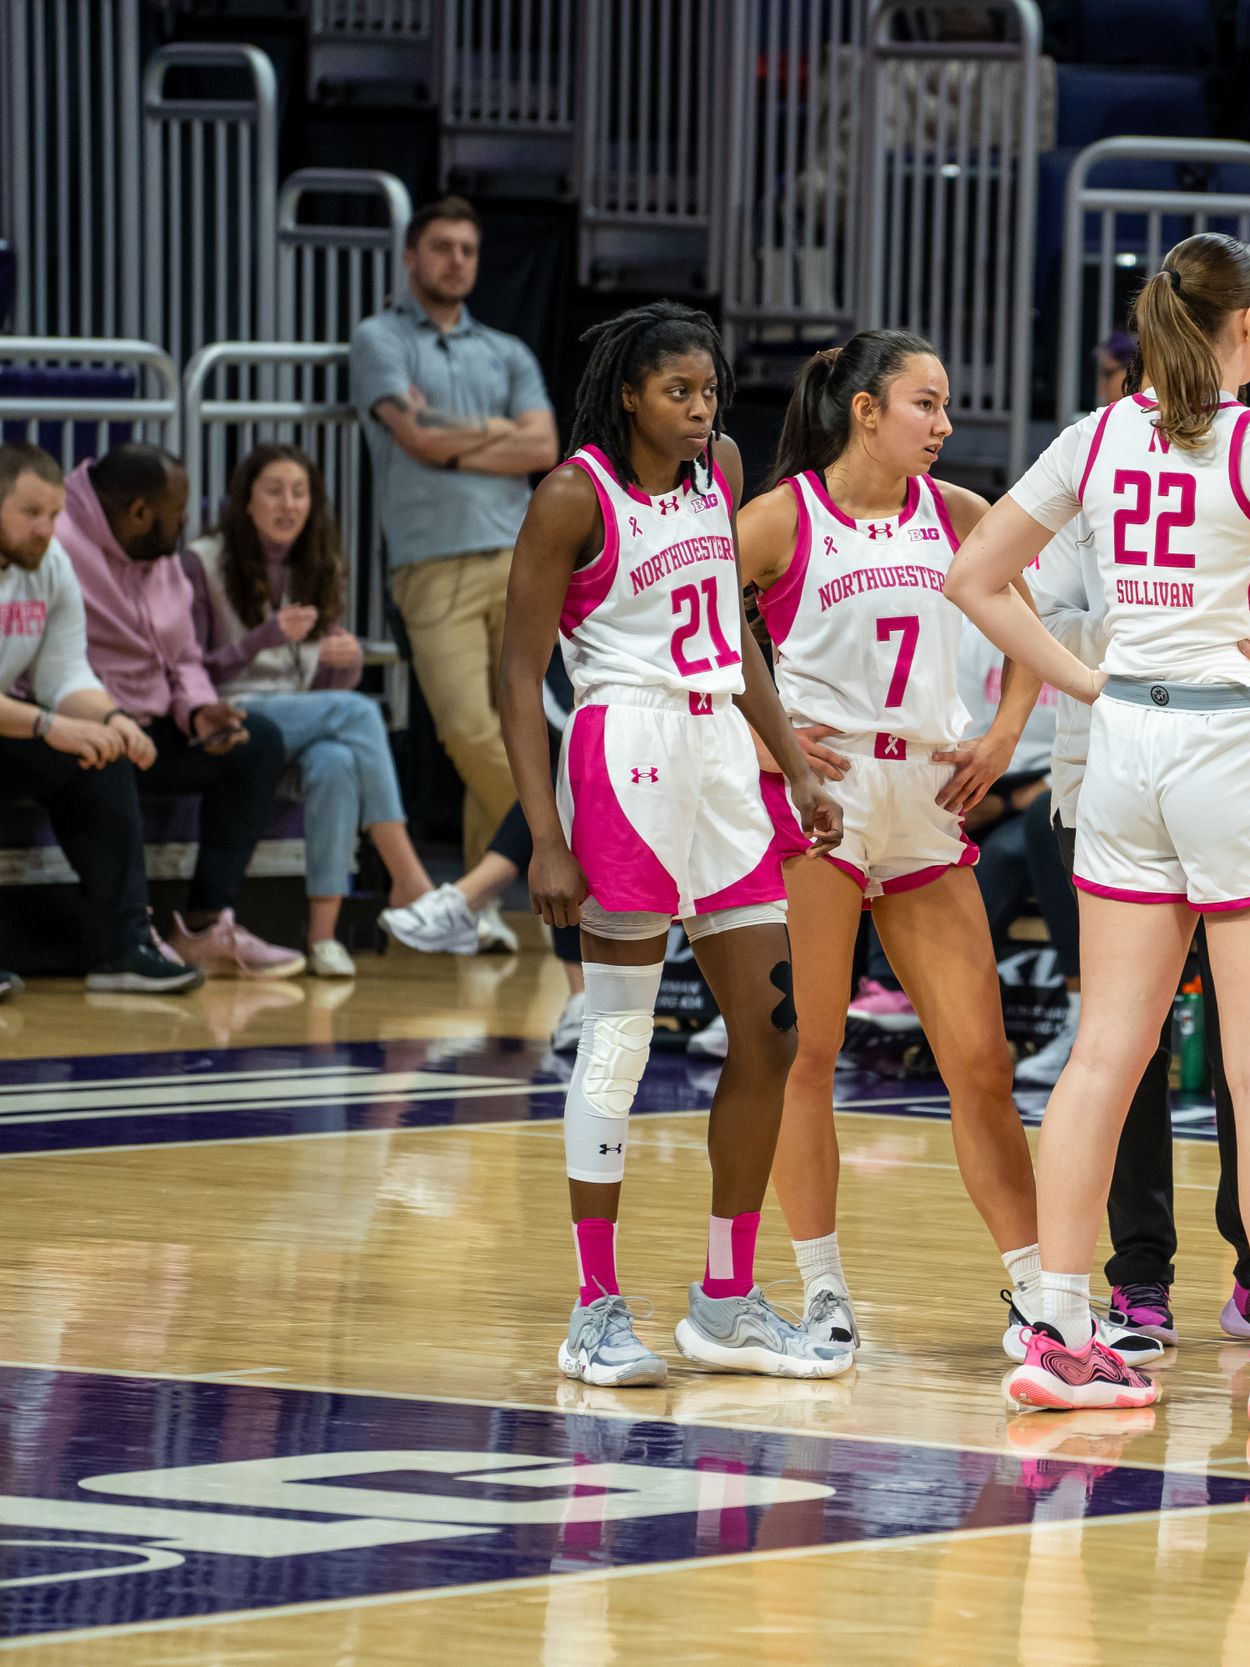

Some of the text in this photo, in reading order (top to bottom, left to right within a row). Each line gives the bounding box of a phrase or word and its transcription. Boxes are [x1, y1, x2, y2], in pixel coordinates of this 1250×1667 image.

[1113, 469, 1197, 568] 22
[629, 535, 735, 596] NORTHWESTER
[818, 565, 946, 612] NORTHWESTER
[1116, 579, 1194, 607] SULLIVAN
[671, 576, 743, 677] 21
[876, 615, 920, 708] 7
